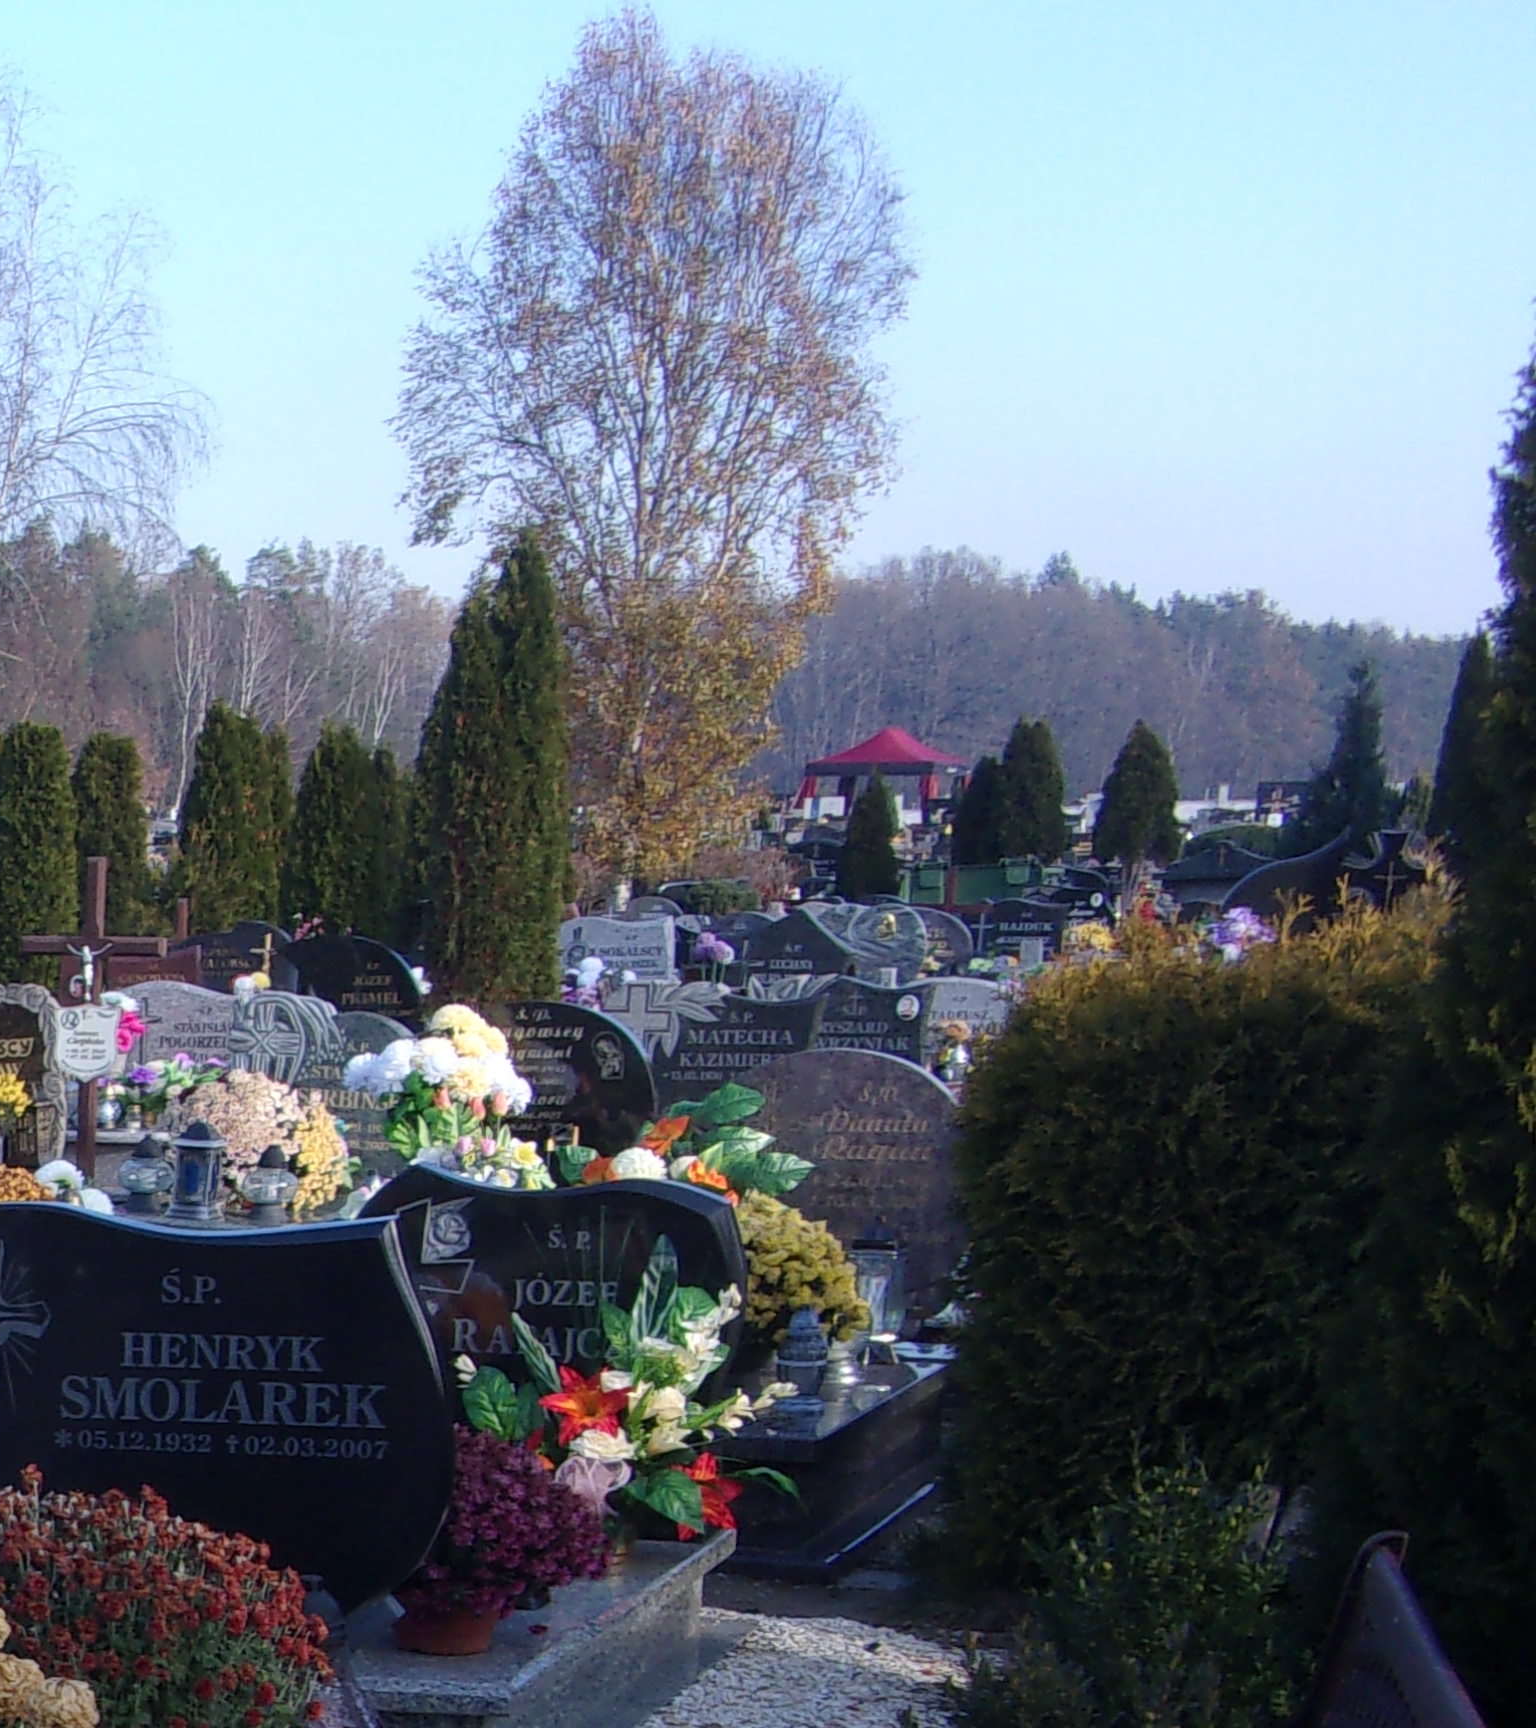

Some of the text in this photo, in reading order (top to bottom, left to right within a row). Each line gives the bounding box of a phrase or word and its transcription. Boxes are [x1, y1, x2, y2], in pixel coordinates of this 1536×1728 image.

[687, 1029, 795, 1046] MATECHA
[678, 1053, 774, 1068] KAZIMIER
[513, 1271, 620, 1310] JÓZEF
[119, 1331, 325, 1372] HENRYK
[59, 1375, 388, 1430] SMOLAREK
